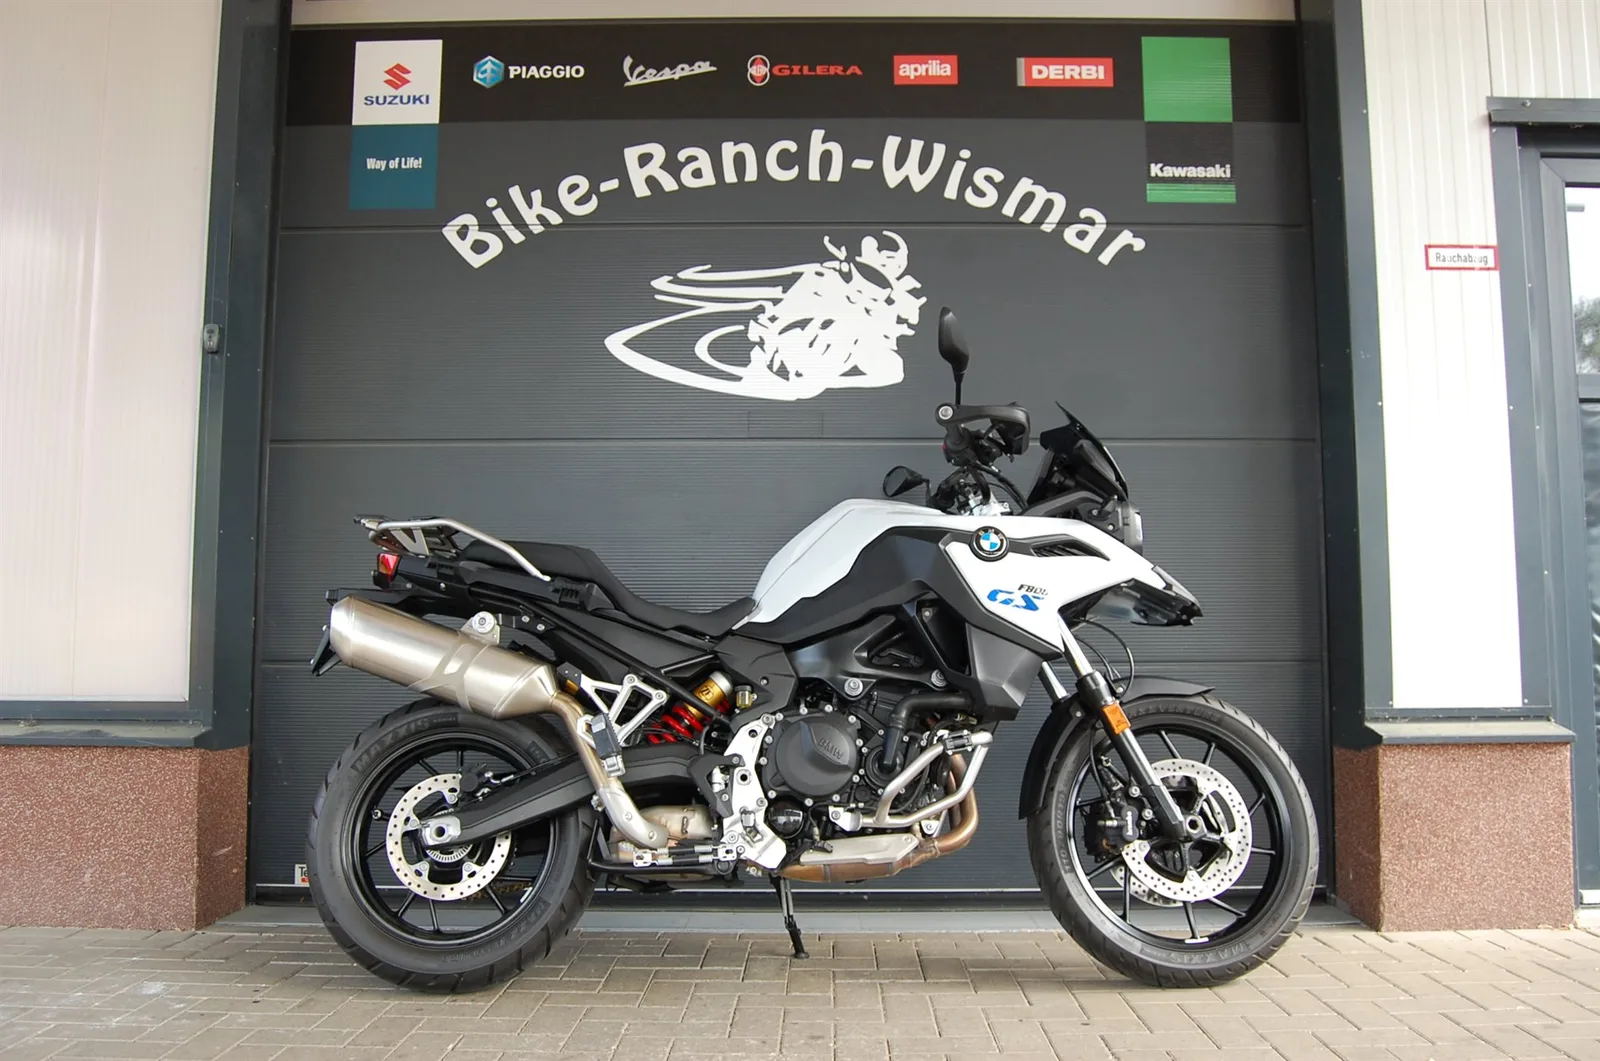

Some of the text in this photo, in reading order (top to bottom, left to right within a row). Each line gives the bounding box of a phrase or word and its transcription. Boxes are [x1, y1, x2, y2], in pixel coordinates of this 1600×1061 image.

[508, 65, 585, 79] PIAGGIO
[622, 55, 718, 87] Vespa
[772, 64, 863, 76] GILERA
[898, 61, 951, 77] aprilia
[1031, 65, 1105, 80] DERBI
[363, 94, 430, 106] SUZUKI
[366, 157, 423, 170] Way of Life!
[1149, 162, 1231, 178] Kawasaki
[441, 128, 1147, 269] Bike-Ranch-Wismar
[986, 588, 1045, 612] GS
